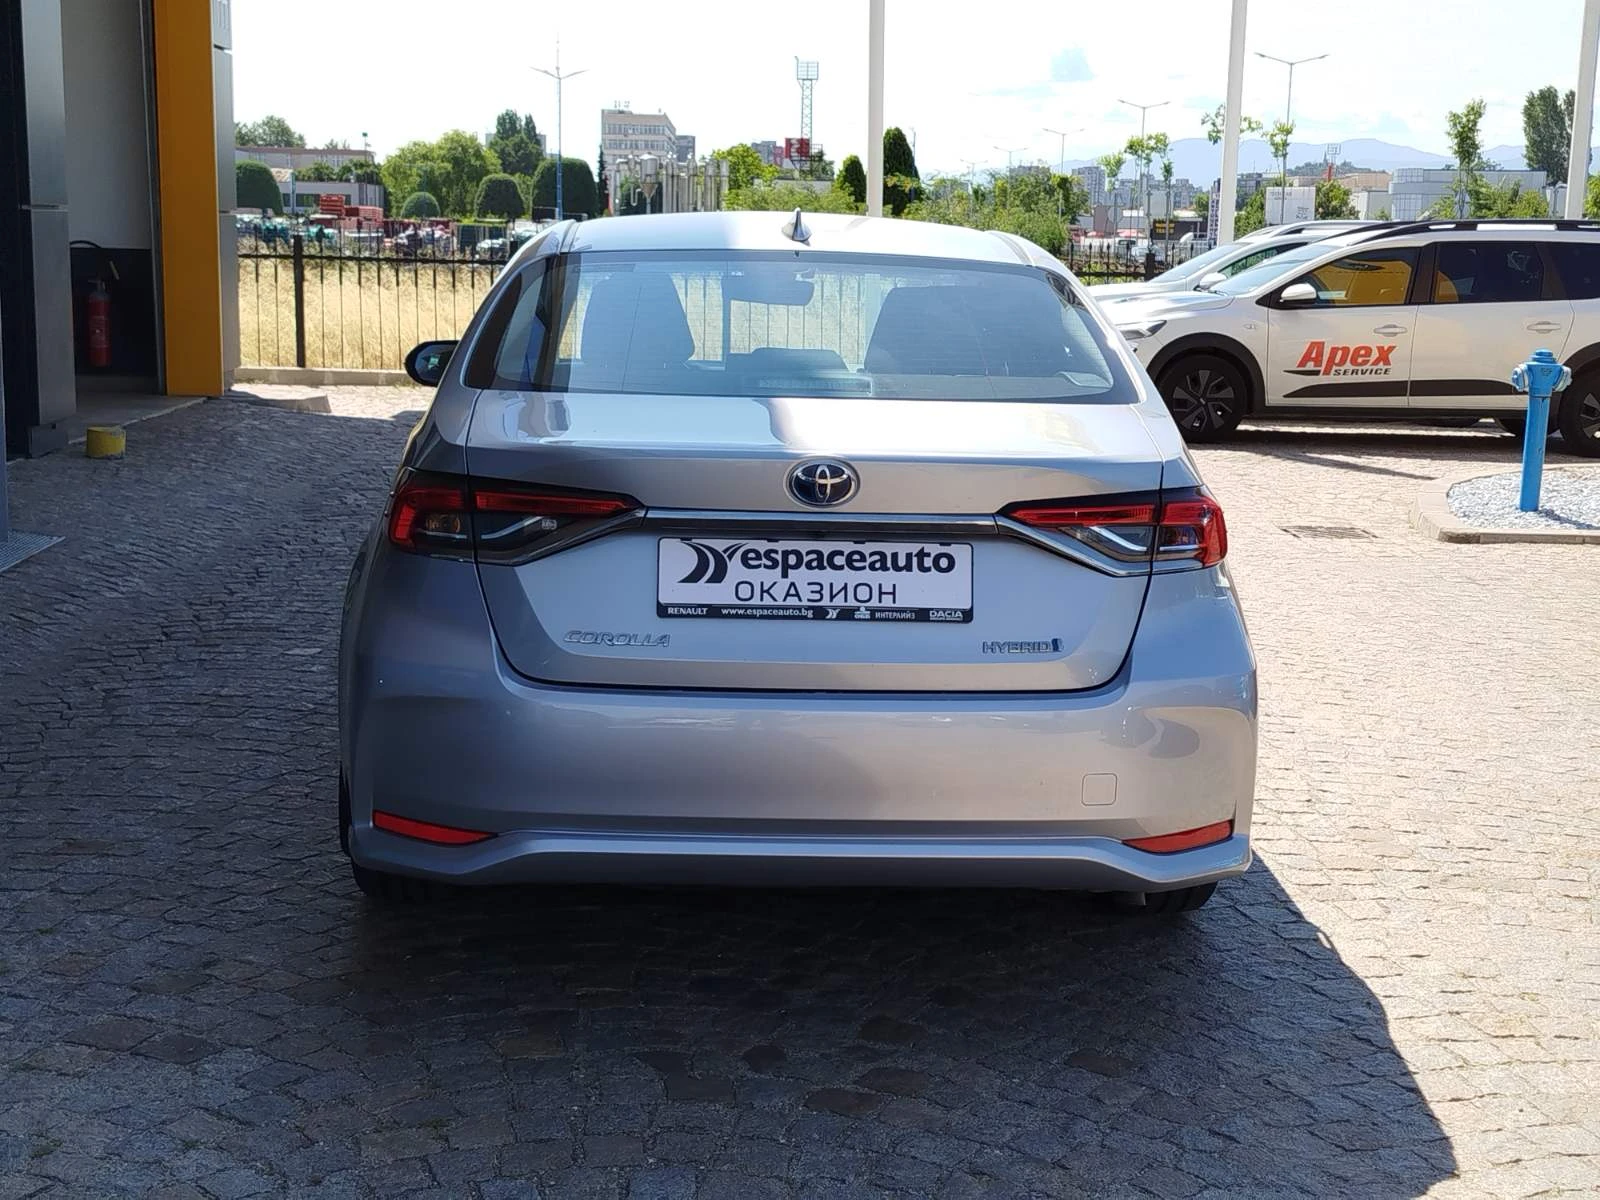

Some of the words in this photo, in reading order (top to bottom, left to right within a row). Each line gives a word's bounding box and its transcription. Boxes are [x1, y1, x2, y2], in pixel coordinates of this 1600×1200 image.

[1296, 341, 1397, 376] Apex
[1333, 368, 1392, 376] SERVICE
[740, 546, 956, 579] espaceauto
[734, 580, 897, 605] ОКАЗИОН
[667, 607, 709, 615] RENAULT
[721, 607, 814, 618] www.espaceauto.bg
[929, 610, 963, 619] DACIA
[564, 630, 671, 648] COROLLA
[982, 640, 1051, 654] HYBRID
